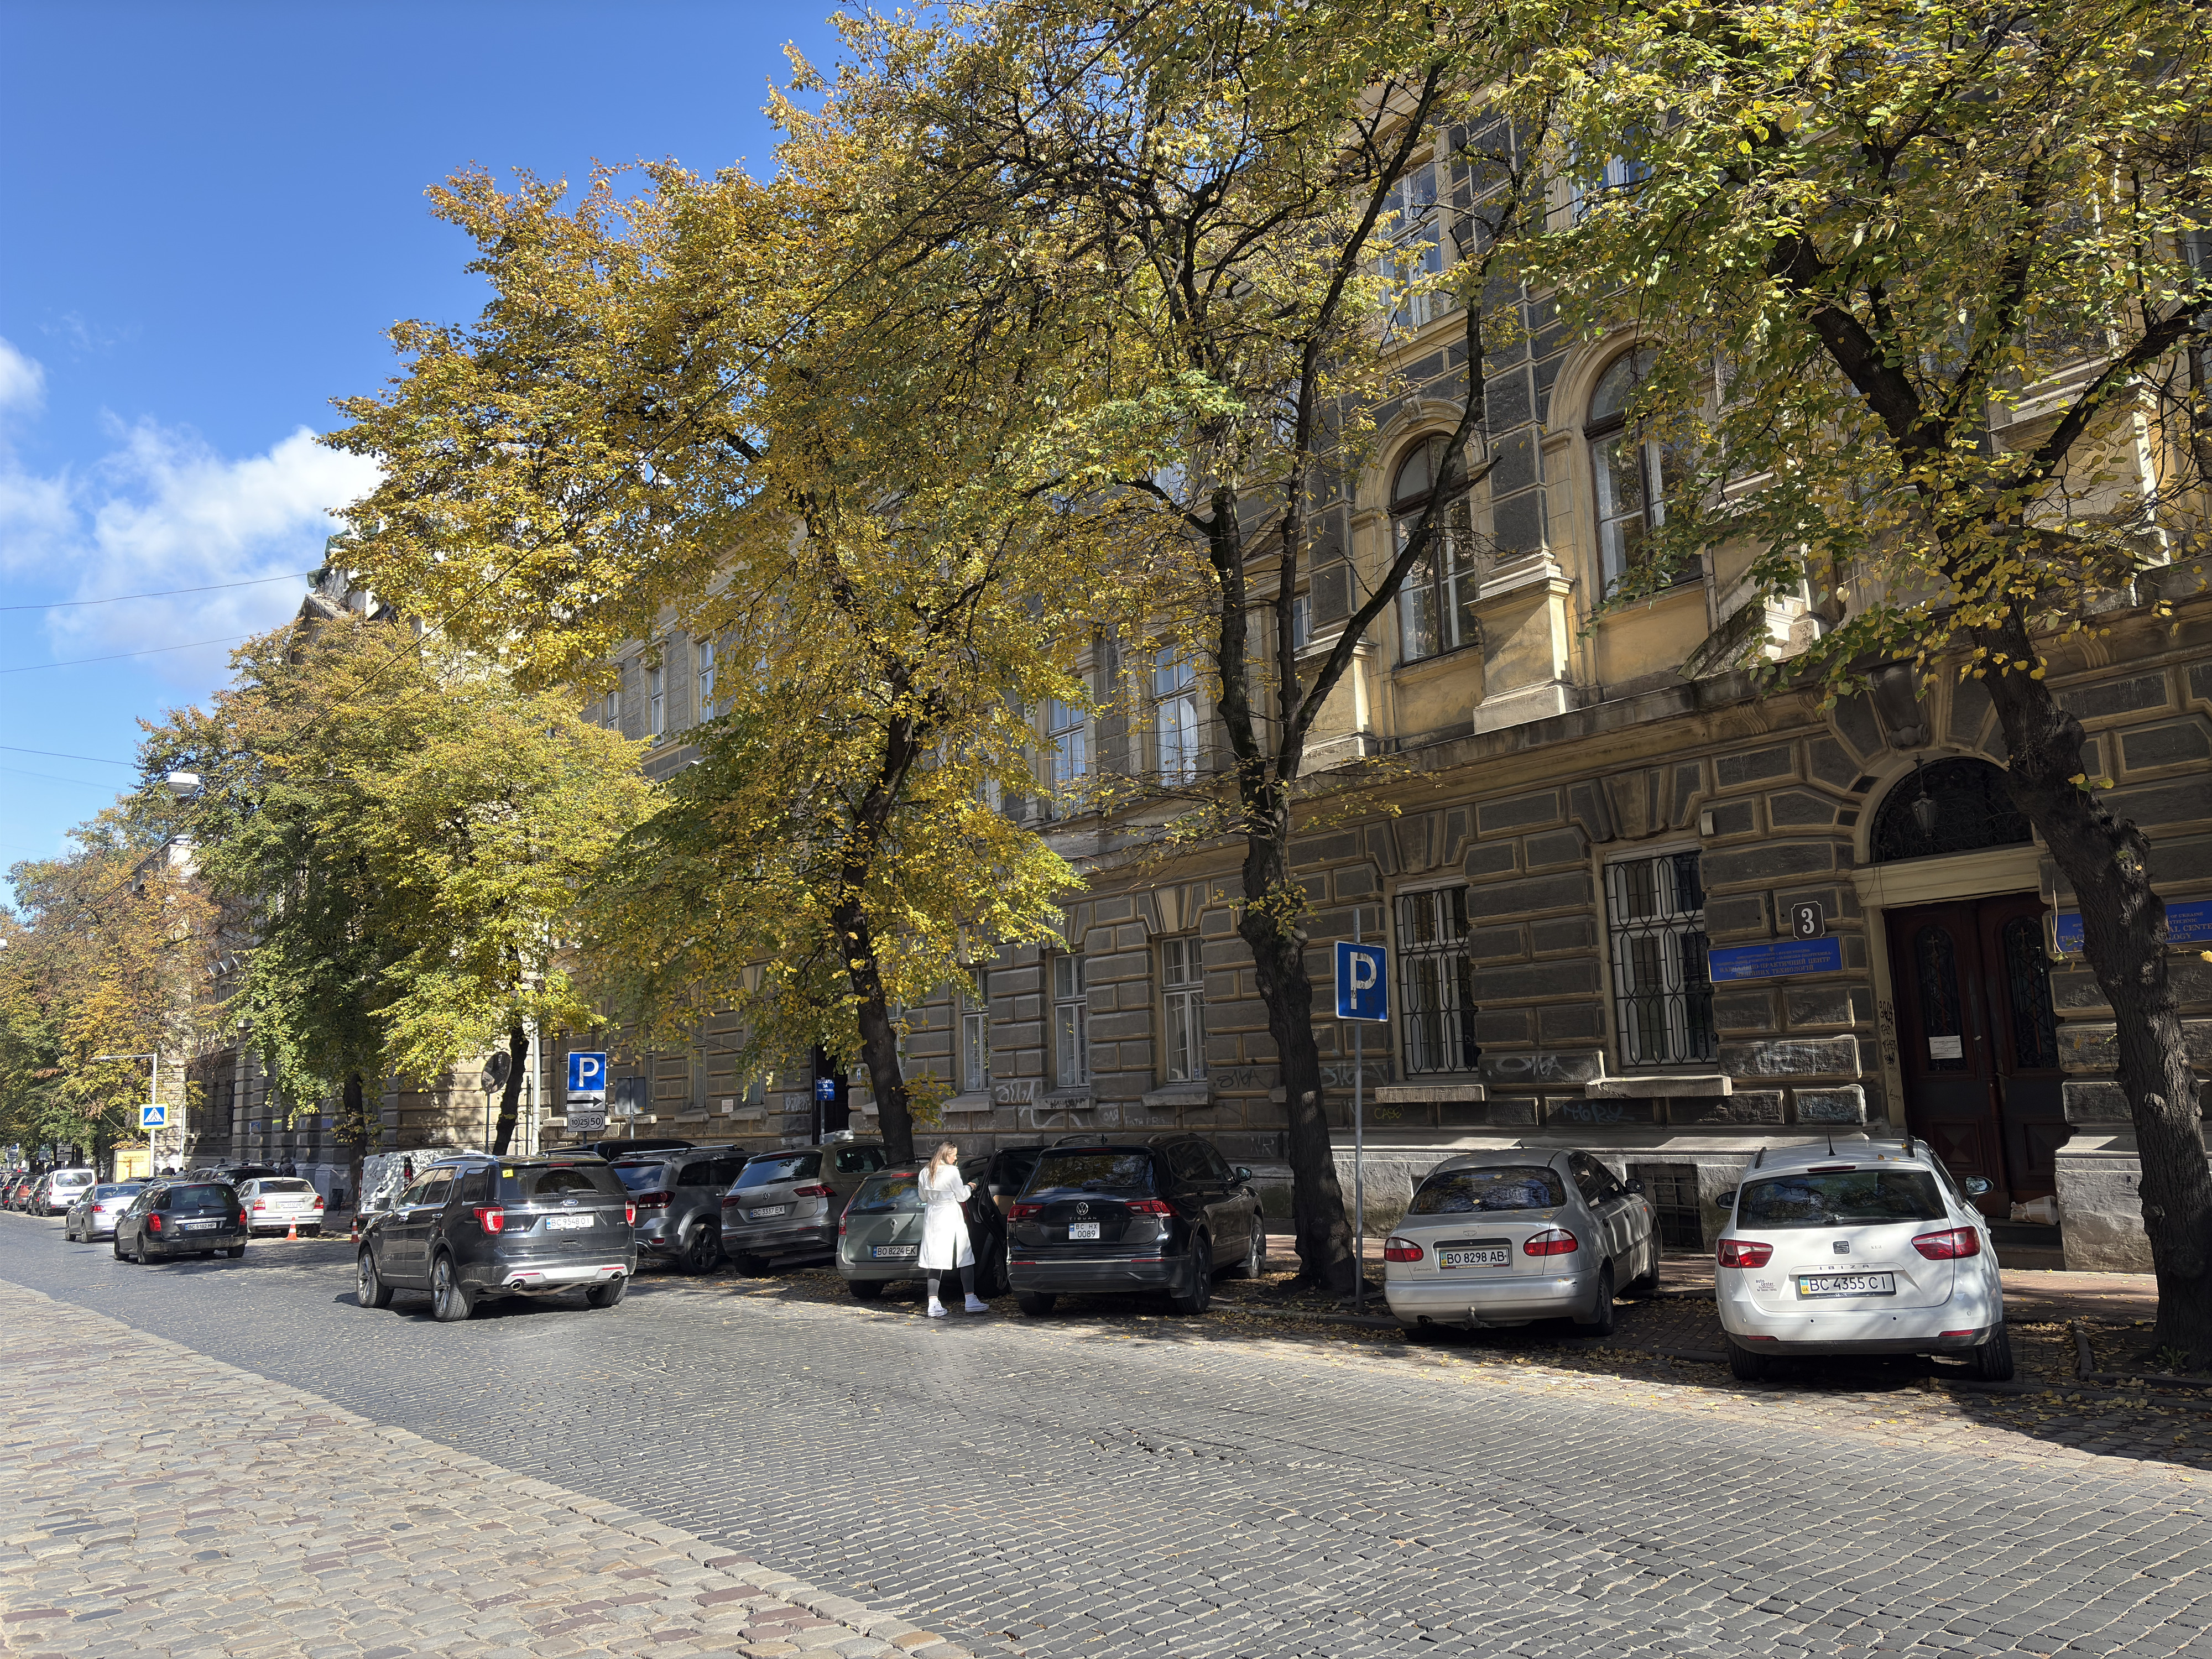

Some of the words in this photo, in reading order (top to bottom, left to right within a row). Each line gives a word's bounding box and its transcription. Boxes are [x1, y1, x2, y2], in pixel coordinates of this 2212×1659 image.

[1802, 908, 1814, 934] 3
[1350, 951, 1377, 1010] P
[579, 1057, 599, 1087] P
[889, 1246, 904, 1255] 8224
[1447, 1253, 1461, 1264] BO
[1464, 1252, 1487, 1263] 8298
[1490, 1251, 1505, 1262] AB
[1809, 1279, 1829, 1291] BC
[1833, 1276, 1865, 1290] 4355
[1869, 1276, 1886, 1290] CI
